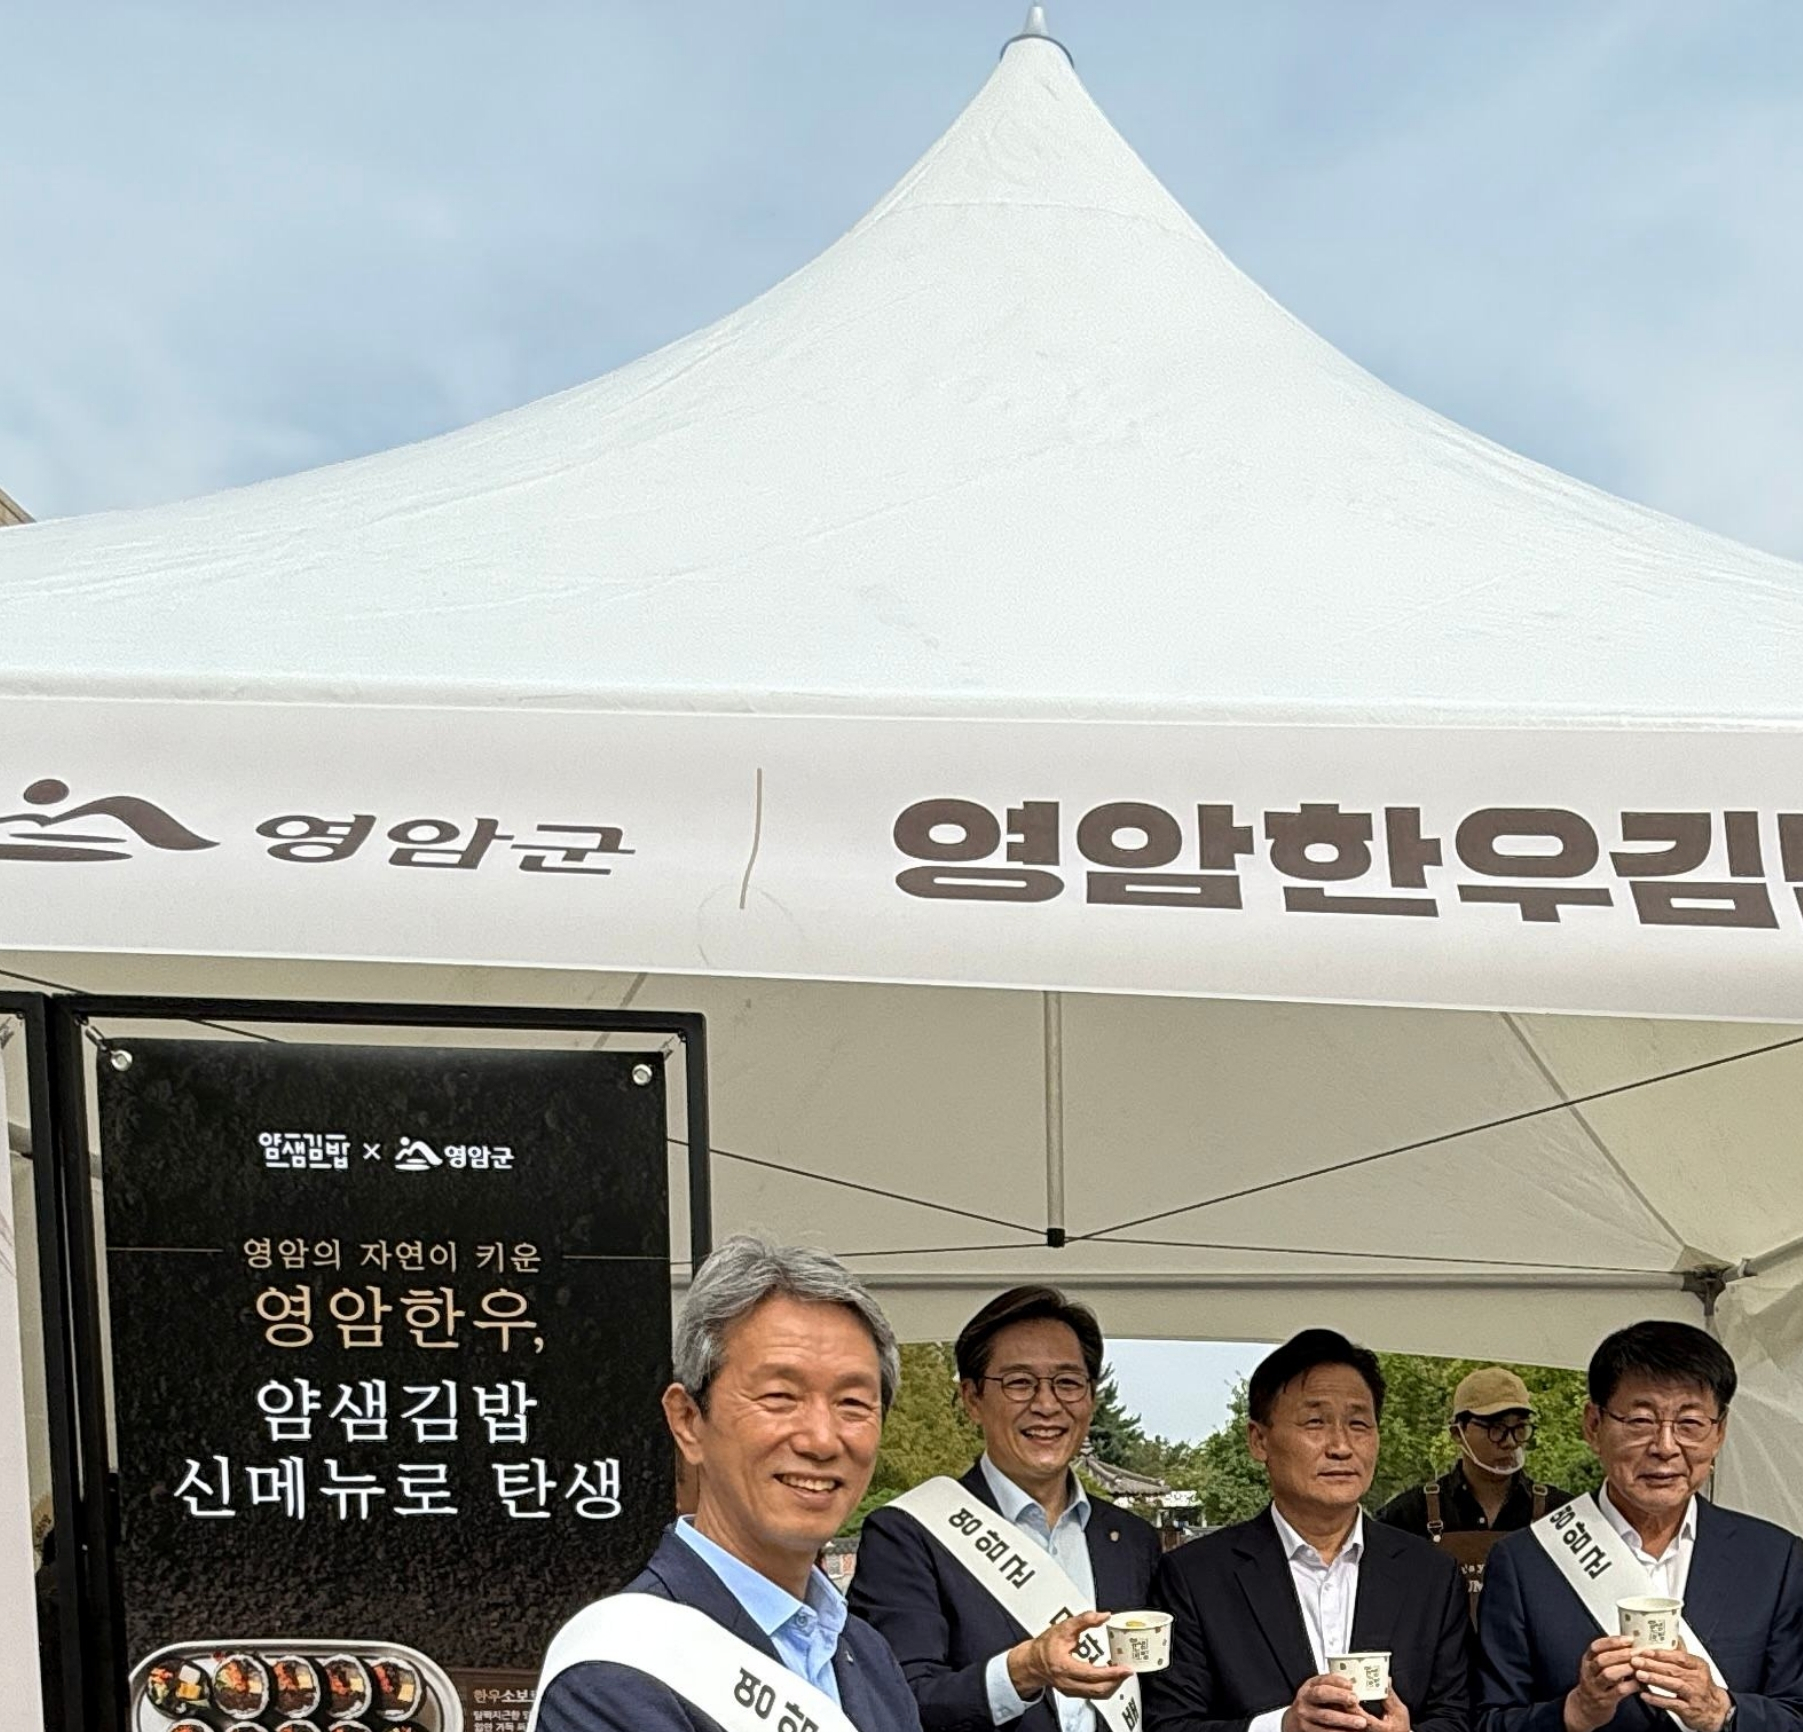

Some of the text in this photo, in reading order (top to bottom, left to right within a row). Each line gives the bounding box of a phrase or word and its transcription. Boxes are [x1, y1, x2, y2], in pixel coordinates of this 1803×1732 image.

[253, 812, 635, 877] 영암군
[258, 1132, 515, 1170] 얌샘김밥 영암군
[243, 1238, 542, 1273] 영암의 자연이 키운
[255, 1286, 545, 1353] 영암한우,
[256, 1378, 538, 1444] 얌샘김밥
[173, 1456, 623, 1521] 신메뉴로 탄생
[947, 1507, 1037, 1590] 영암군
[1549, 1505, 1612, 1580] 영암군
